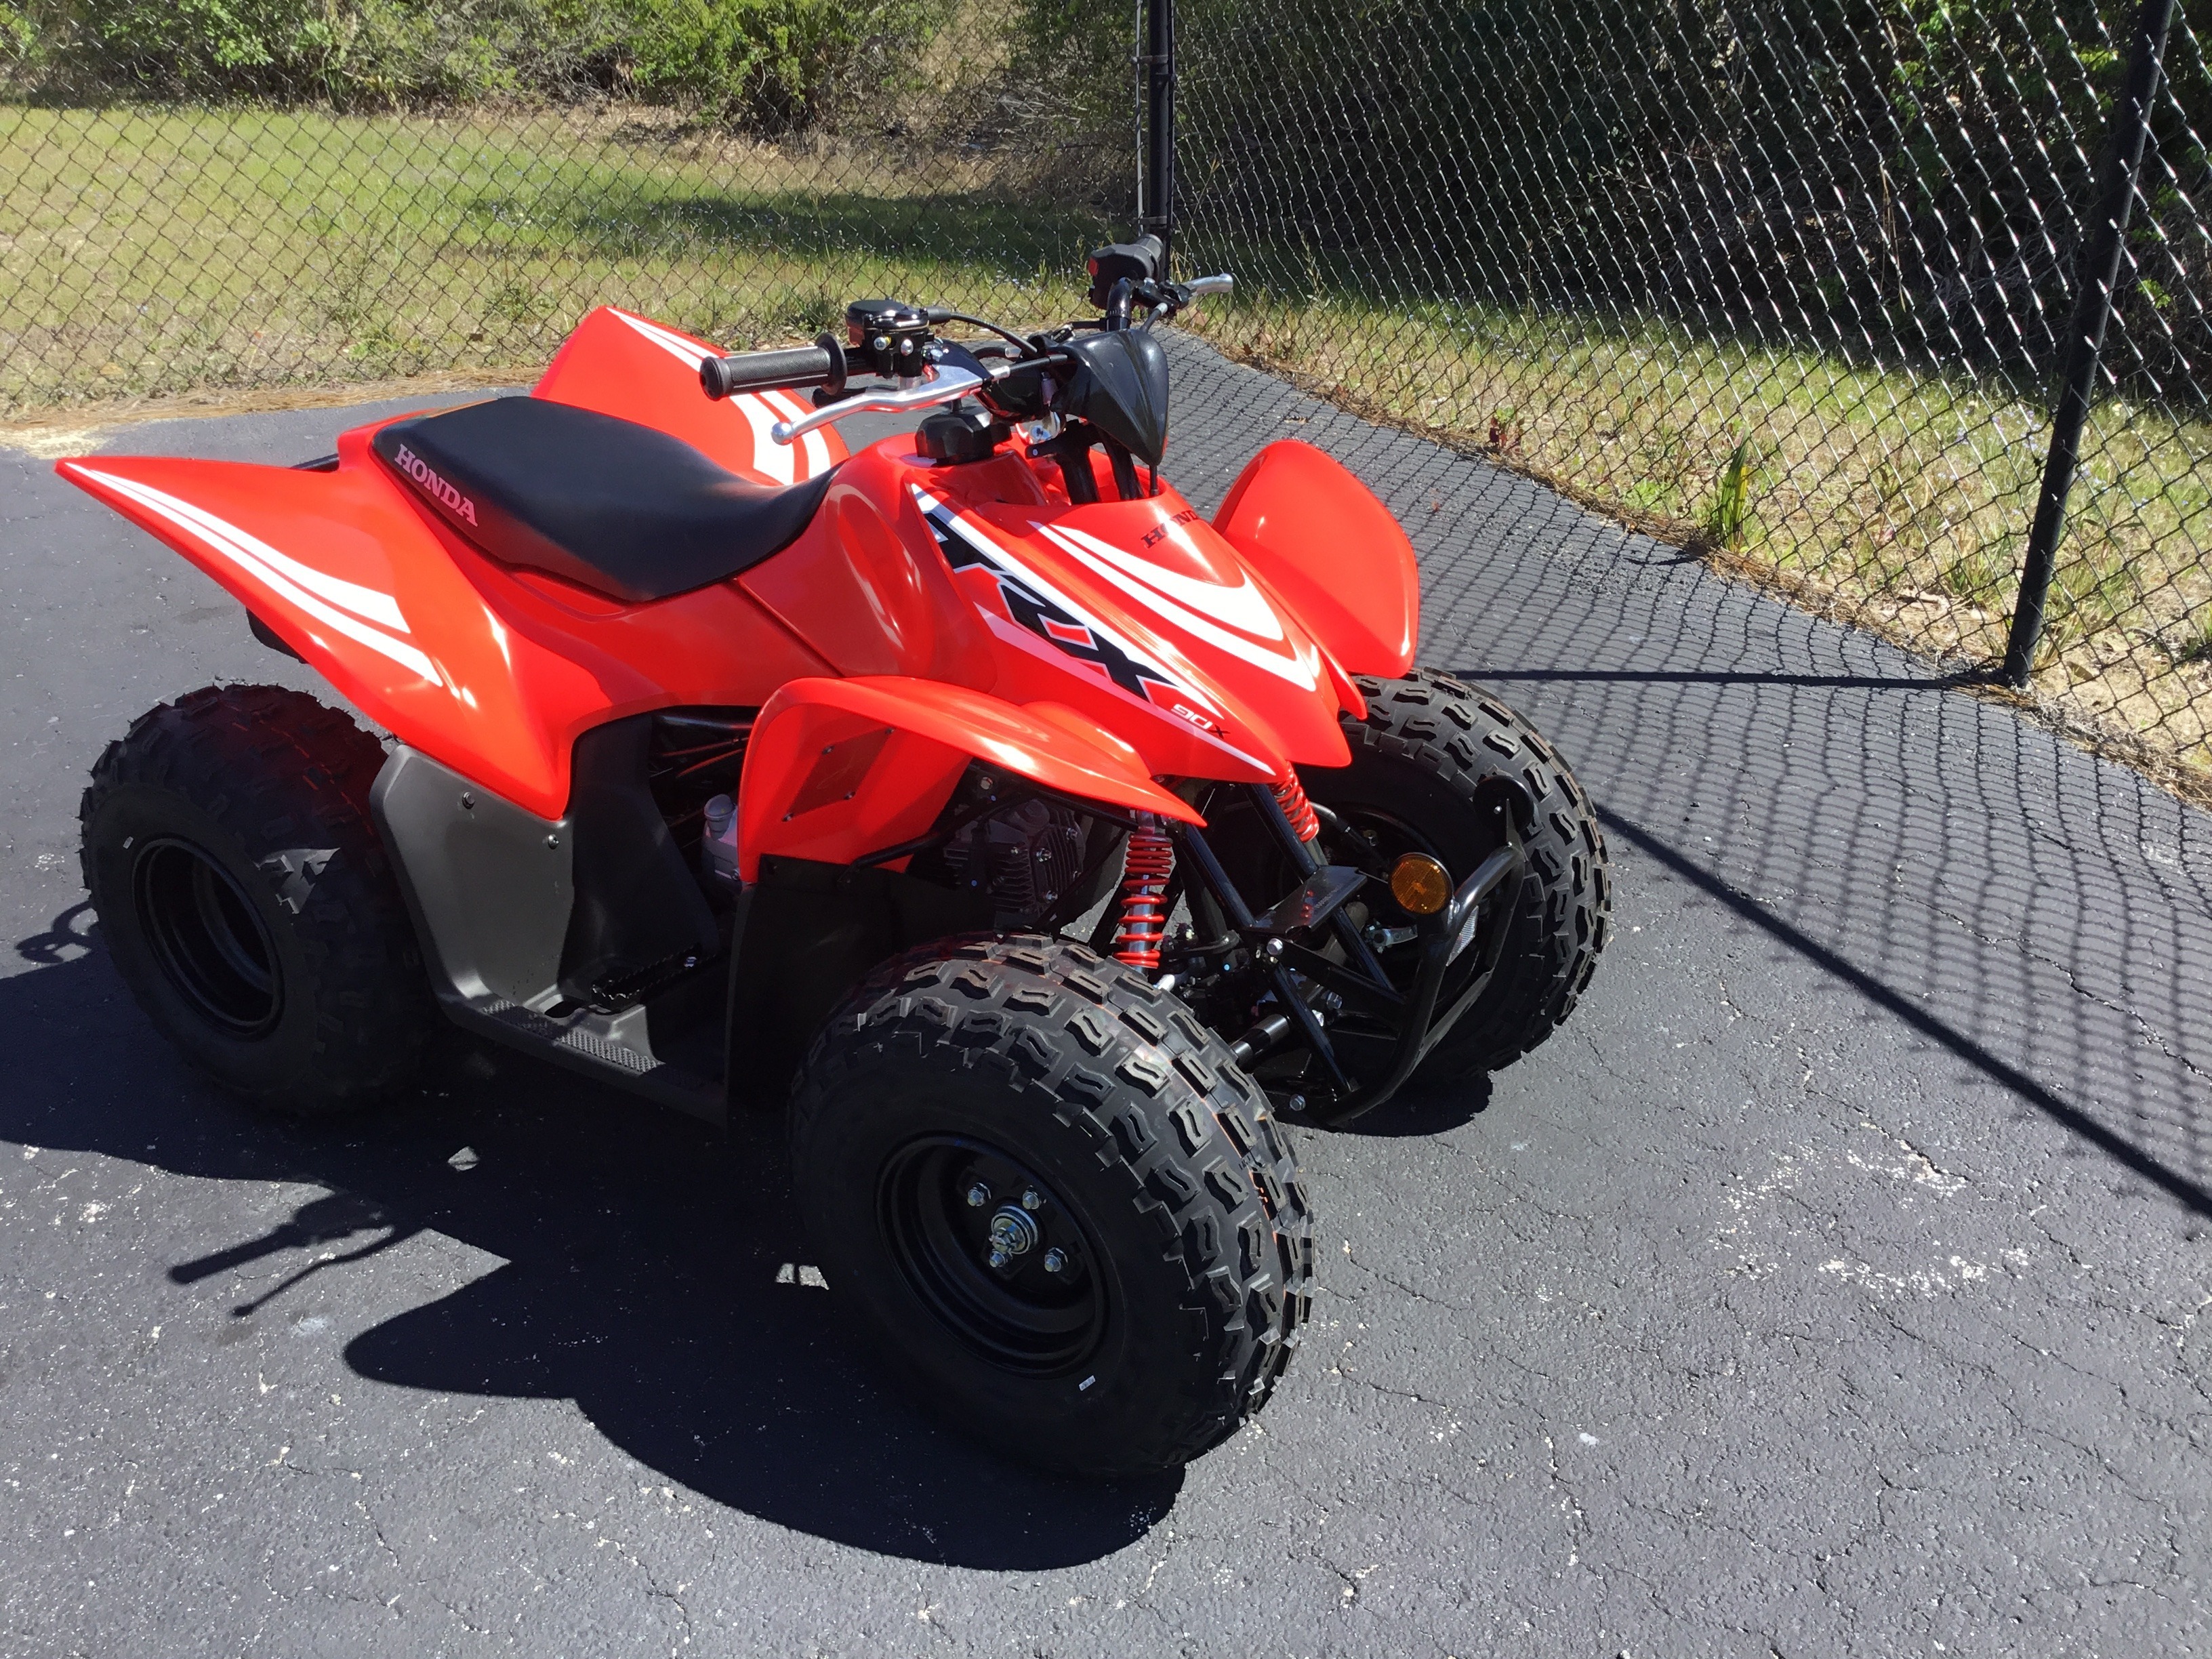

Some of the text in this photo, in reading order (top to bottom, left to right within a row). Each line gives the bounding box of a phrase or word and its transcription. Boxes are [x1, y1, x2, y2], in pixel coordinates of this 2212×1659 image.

[394, 443, 478, 527] HONDA
[1141, 510, 1199, 549] HND
[1170, 703, 1231, 739] 90X
